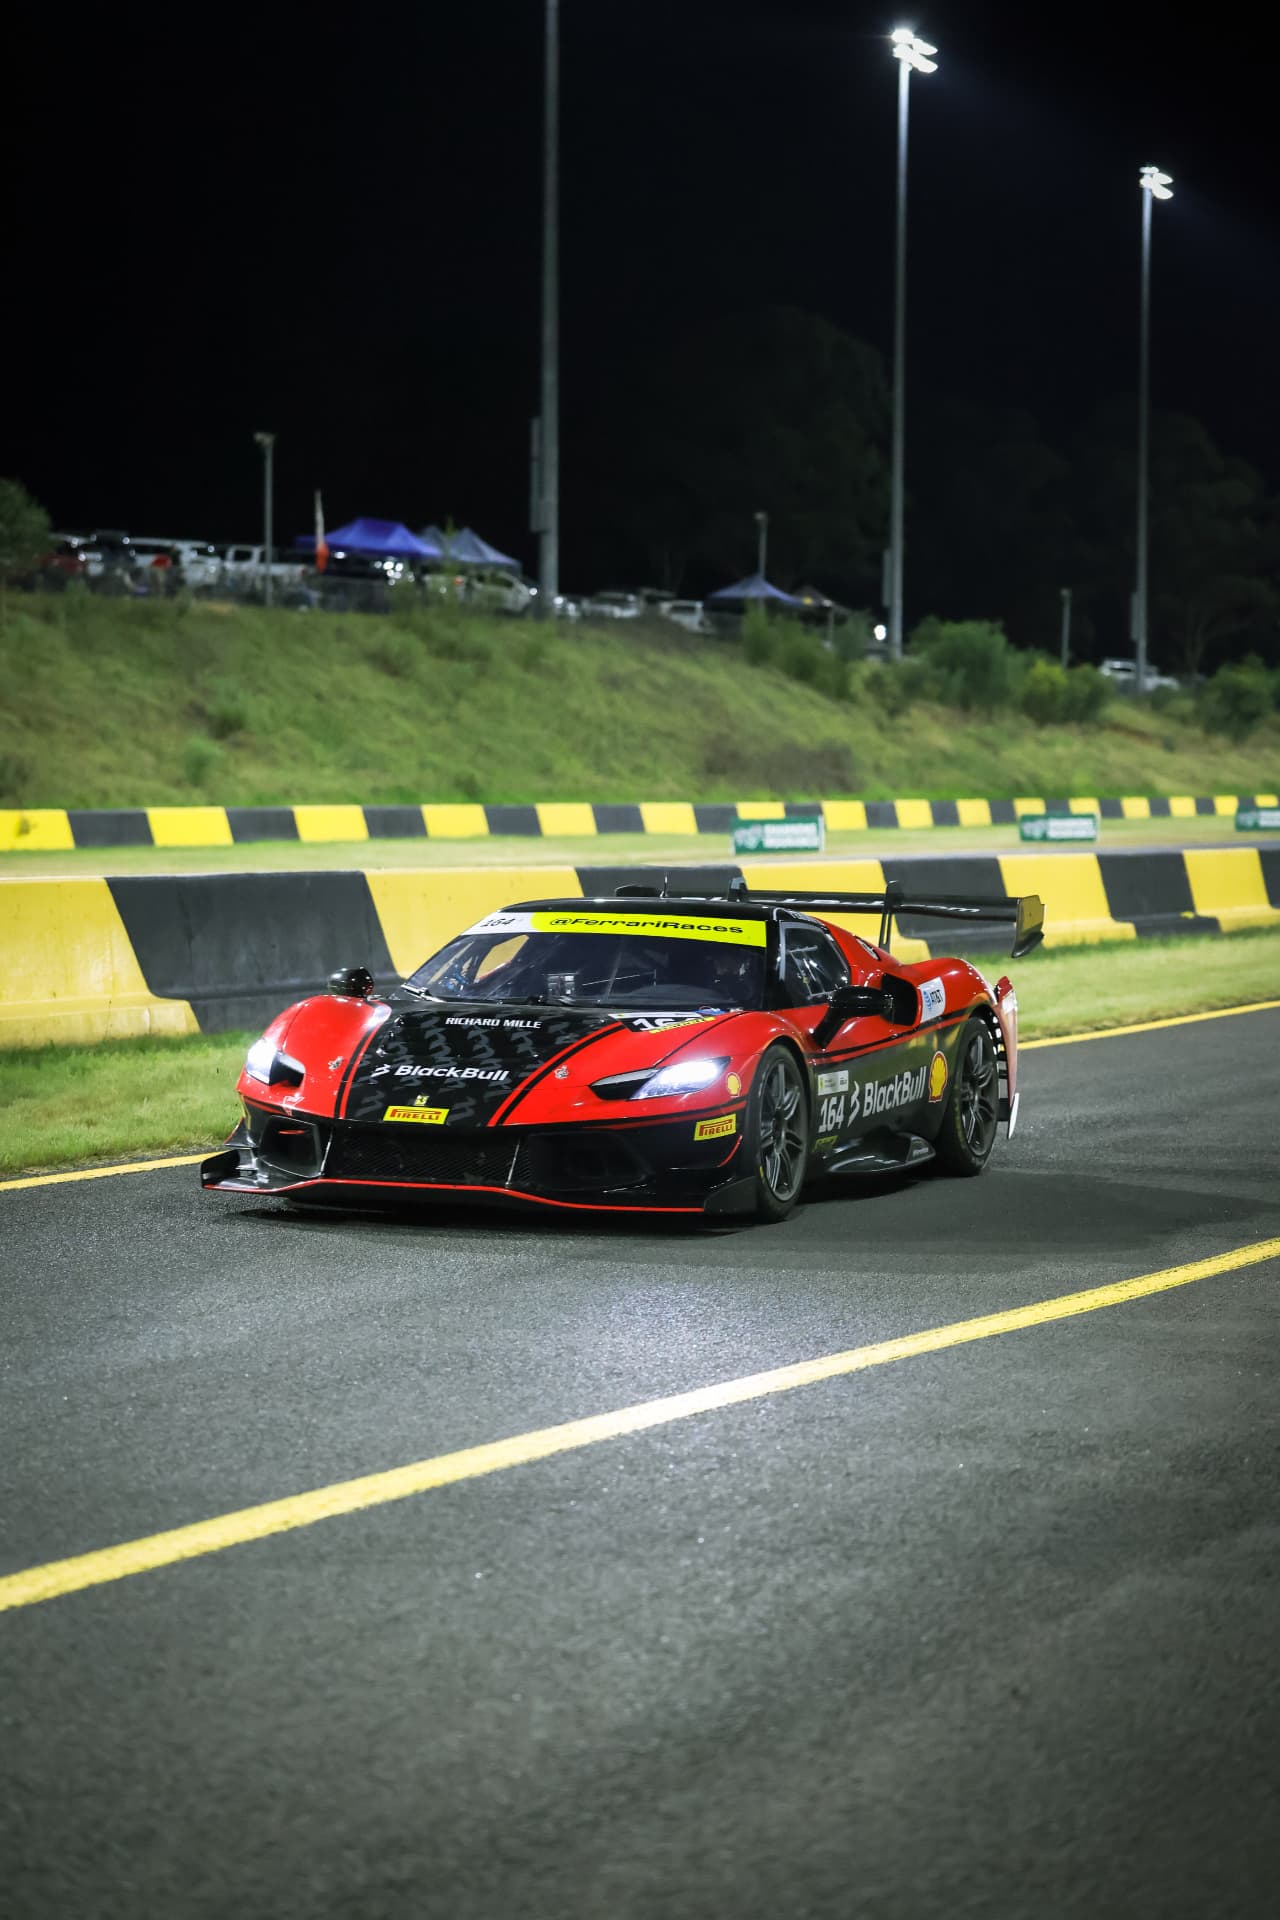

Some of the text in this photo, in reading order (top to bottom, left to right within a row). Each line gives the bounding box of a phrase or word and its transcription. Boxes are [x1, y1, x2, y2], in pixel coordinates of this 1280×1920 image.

[550, 918, 743, 934] @FerrariRaces
[445, 1017, 543, 1029] RICHARD MILLE
[394, 1065, 510, 1081] BlackBull
[862, 1065, 927, 1118] BlackBull
[389, 1108, 442, 1121] PIRELLI
[818, 1095, 845, 1133] 164
[698, 1119, 733, 1137] PIRELLI
